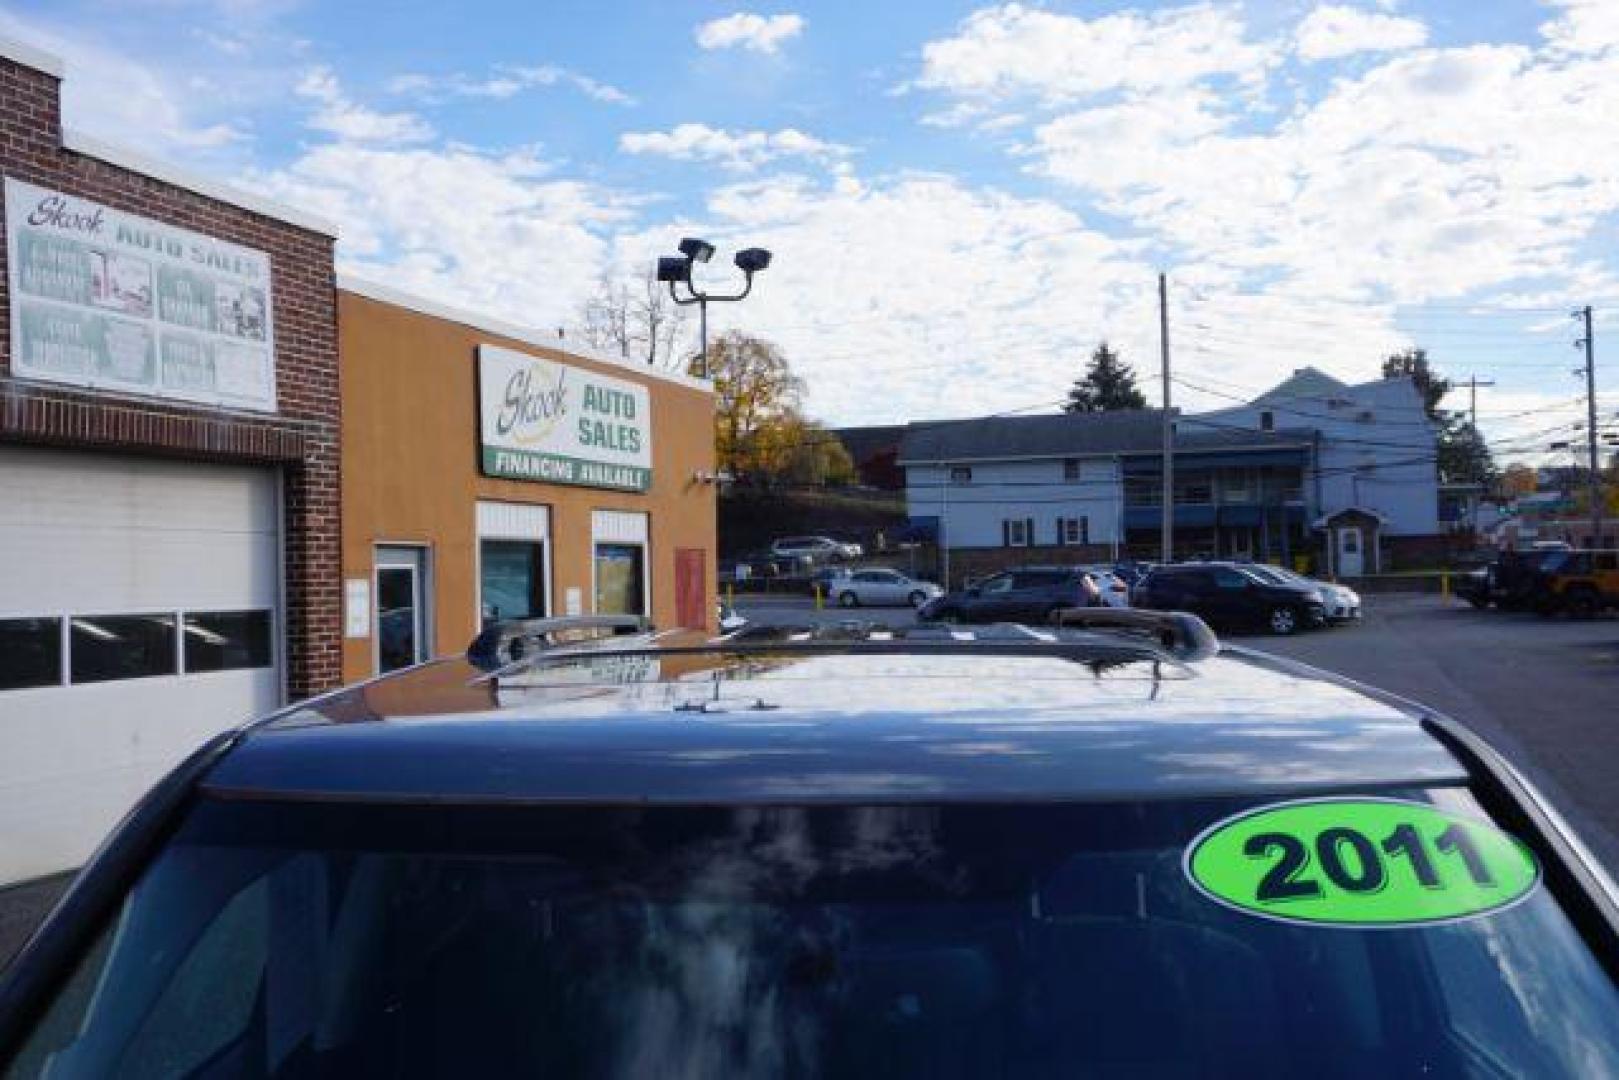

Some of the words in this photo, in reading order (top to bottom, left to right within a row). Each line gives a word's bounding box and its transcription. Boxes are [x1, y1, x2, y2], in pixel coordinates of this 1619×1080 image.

[583, 383, 636, 420] AUTO
[578, 417, 641, 453] SALES
[495, 451, 572, 479] FINANCING
[1243, 823, 1498, 902] 2011
